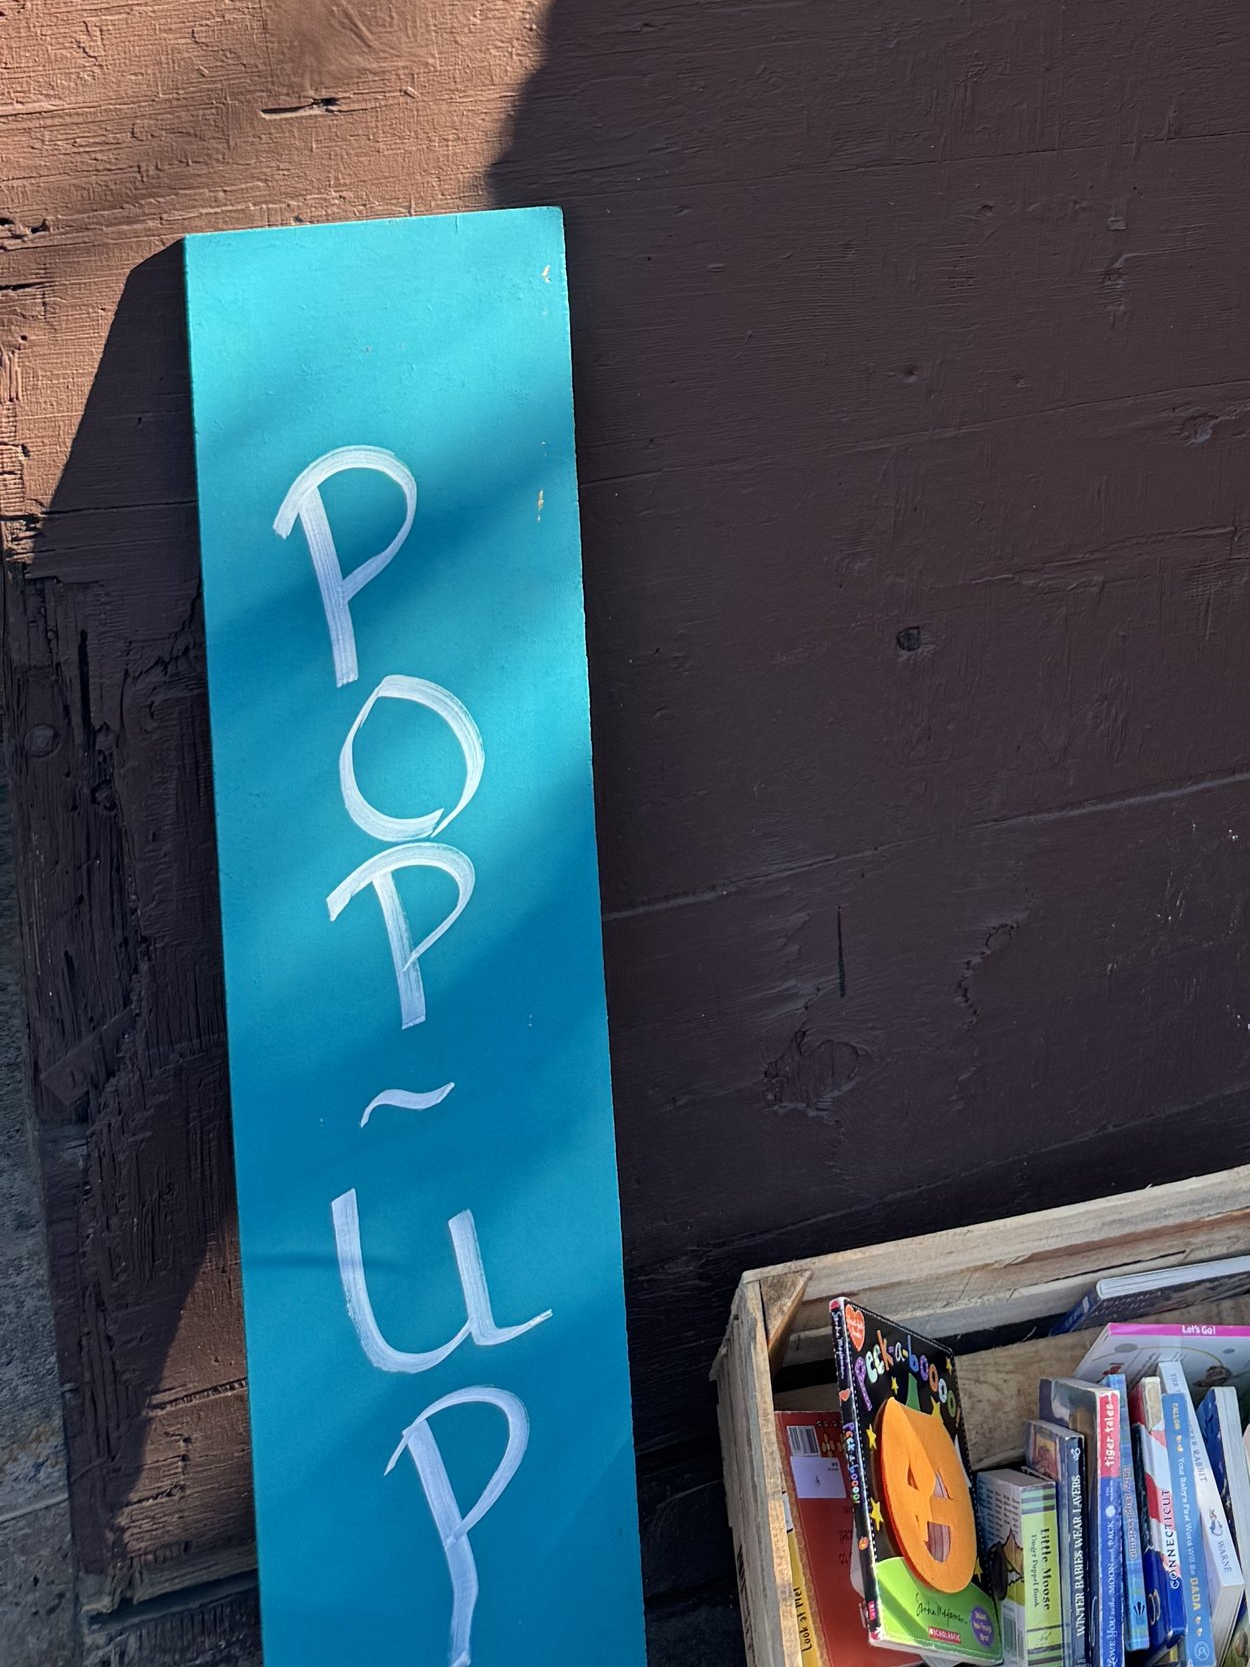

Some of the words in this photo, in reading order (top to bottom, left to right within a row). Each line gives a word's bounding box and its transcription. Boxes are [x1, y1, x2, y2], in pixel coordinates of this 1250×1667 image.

[1182, 1324, 1200, 1335] Let's
[1201, 1324, 1217, 1336] Go!
[1104, 1402, 1116, 1433] tales
[1104, 1435, 1117, 1468] tiger
[1177, 1456, 1186, 1478] Your
[1071, 1475, 1083, 1513] LAYERS
[1179, 1477, 1189, 1502] Baby's
[1039, 1527, 1050, 1564] Little
[1072, 1516, 1084, 1548] WEAR
[1107, 1520, 1115, 1546] BACK
[1161, 1489, 1181, 1590] CONNECTICUT
[1185, 1521, 1194, 1544] Word
[1073, 1550, 1085, 1590] BABIES
[1217, 1540, 1233, 1574] WARNE
[1042, 1567, 1051, 1611] Moose
[1107, 1563, 1116, 1595] MOON
[1189, 1577, 1201, 1612] DADA
[793, 1587, 804, 1609] Me!
[1074, 1593, 1087, 1637] WINTER
[1107, 1615, 1119, 1640] YOU
[799, 1626, 813, 1652] Look
